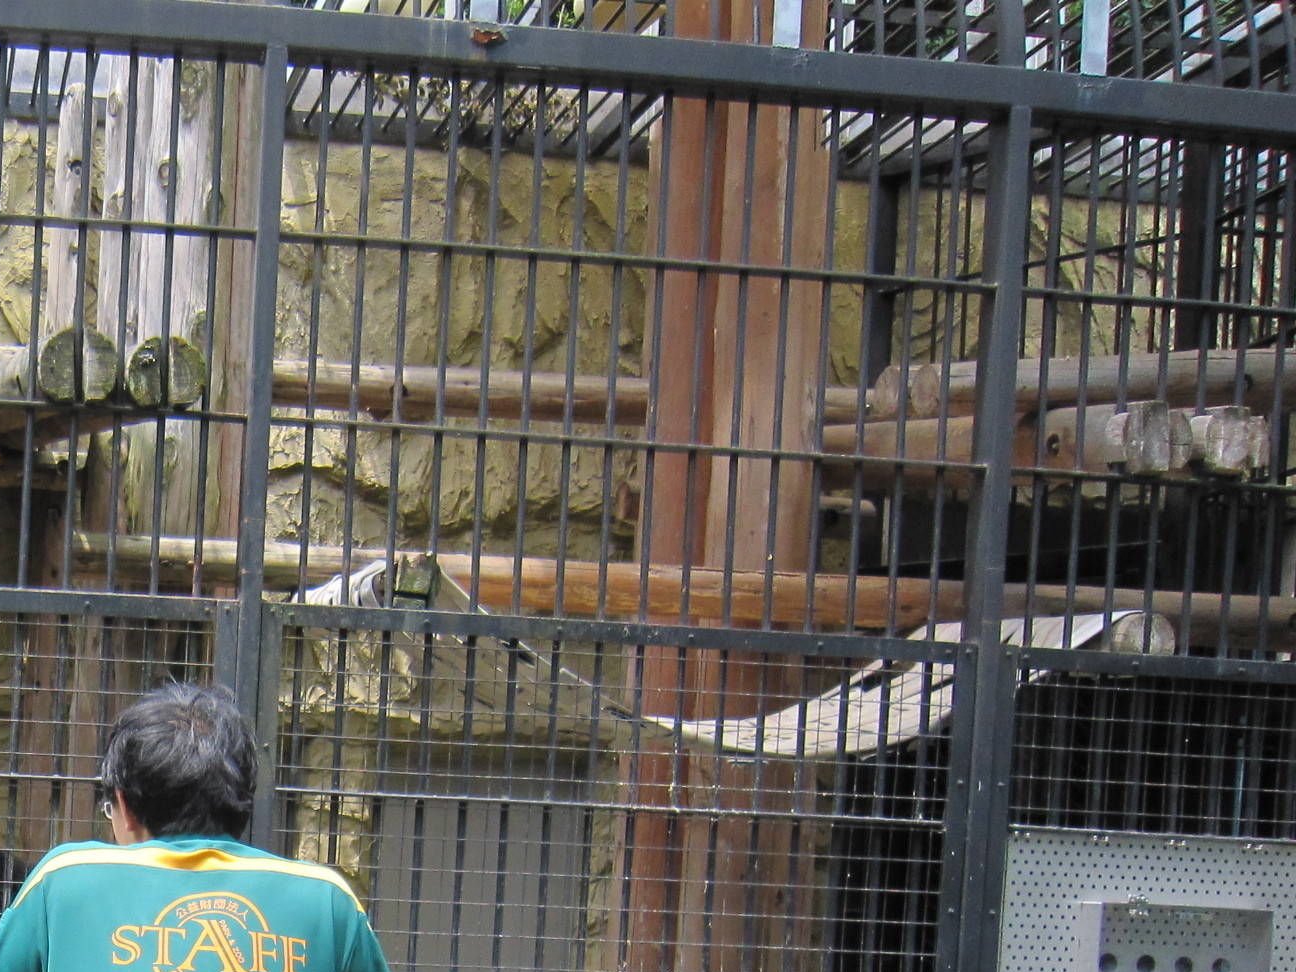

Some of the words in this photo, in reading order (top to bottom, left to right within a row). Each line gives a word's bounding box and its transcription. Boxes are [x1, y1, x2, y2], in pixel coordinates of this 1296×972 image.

[175, 897, 249, 922] 公益財団法人
[231, 947, 245, 964] ZOO
